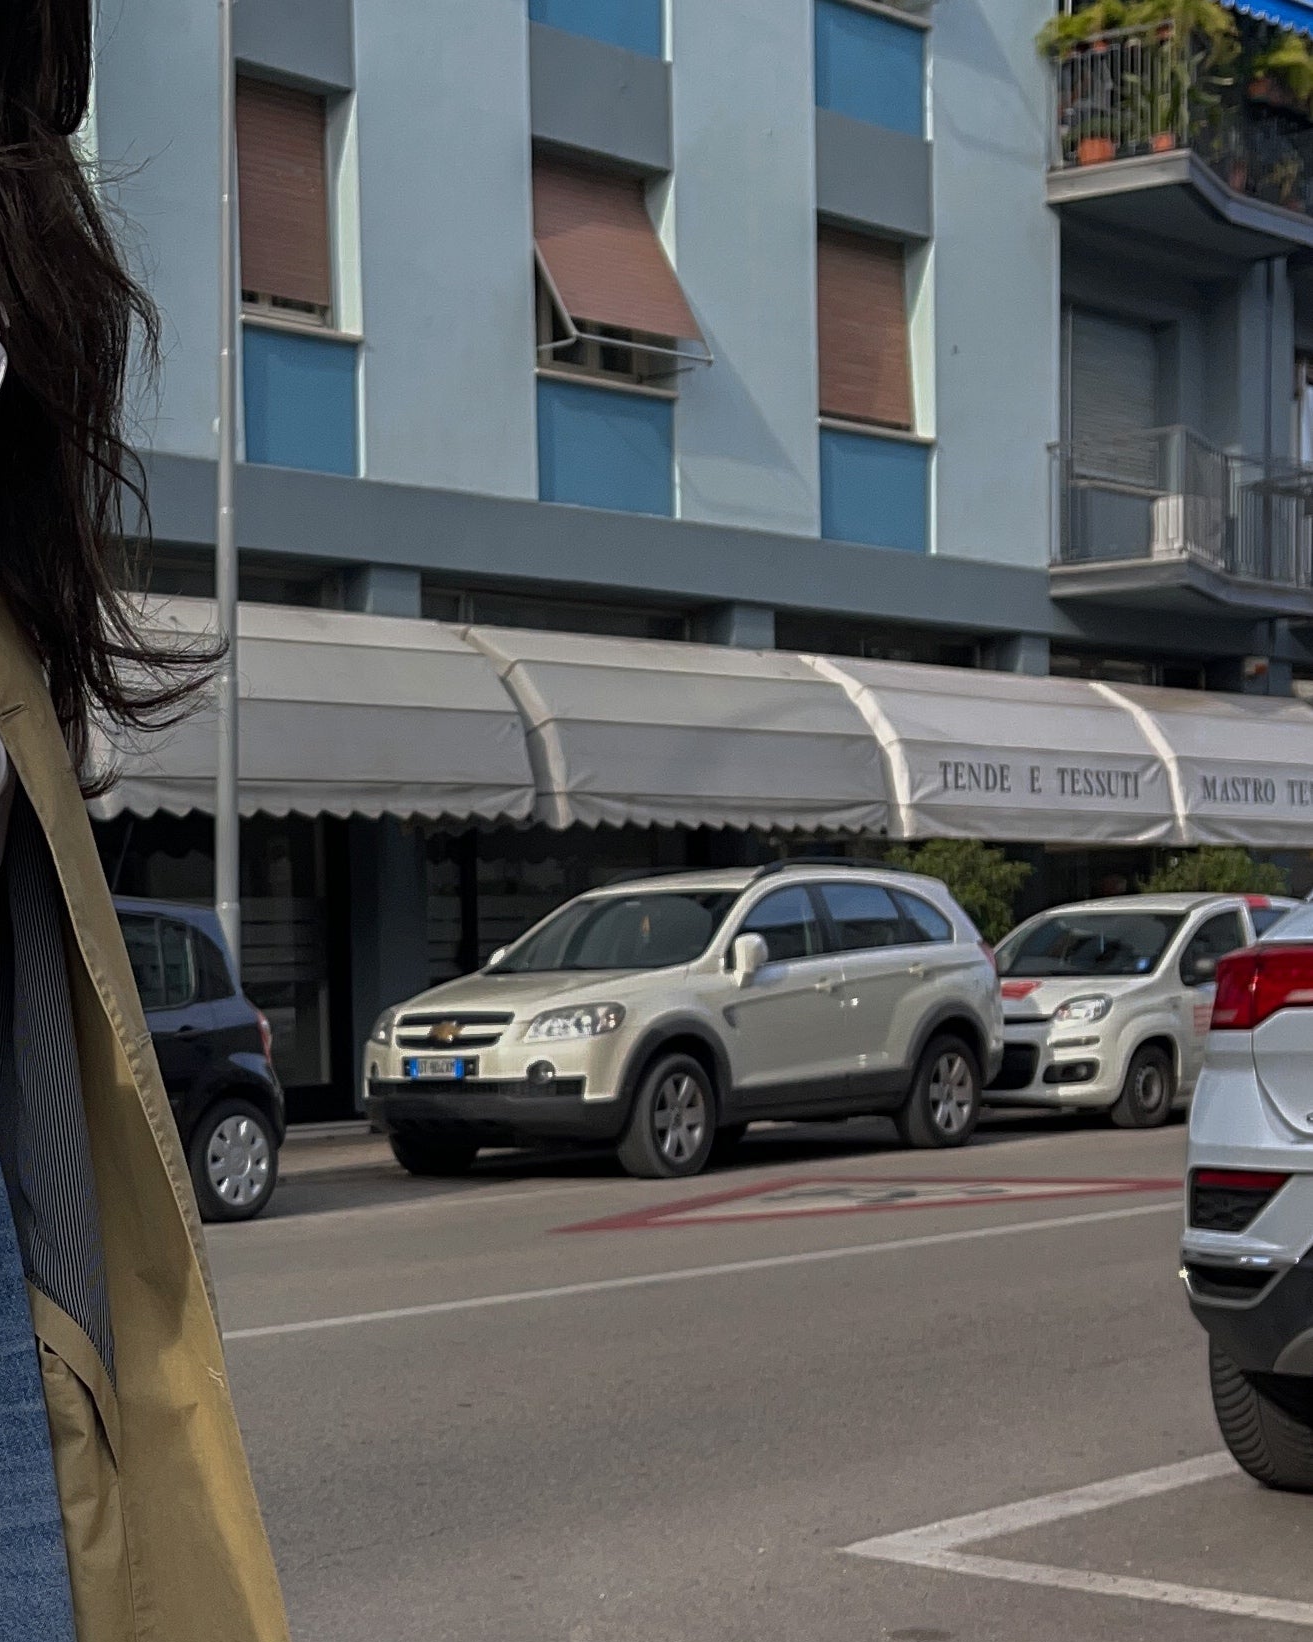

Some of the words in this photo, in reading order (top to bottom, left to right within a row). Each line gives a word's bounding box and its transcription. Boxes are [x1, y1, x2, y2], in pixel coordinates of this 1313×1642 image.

[939, 760, 1012, 793] TENDE
[1029, 765, 1042, 794] E
[1056, 766, 1141, 800] TESSUTI
[1200, 775, 1276, 805] MASTRO
[1287, 779, 1313, 807] TE
